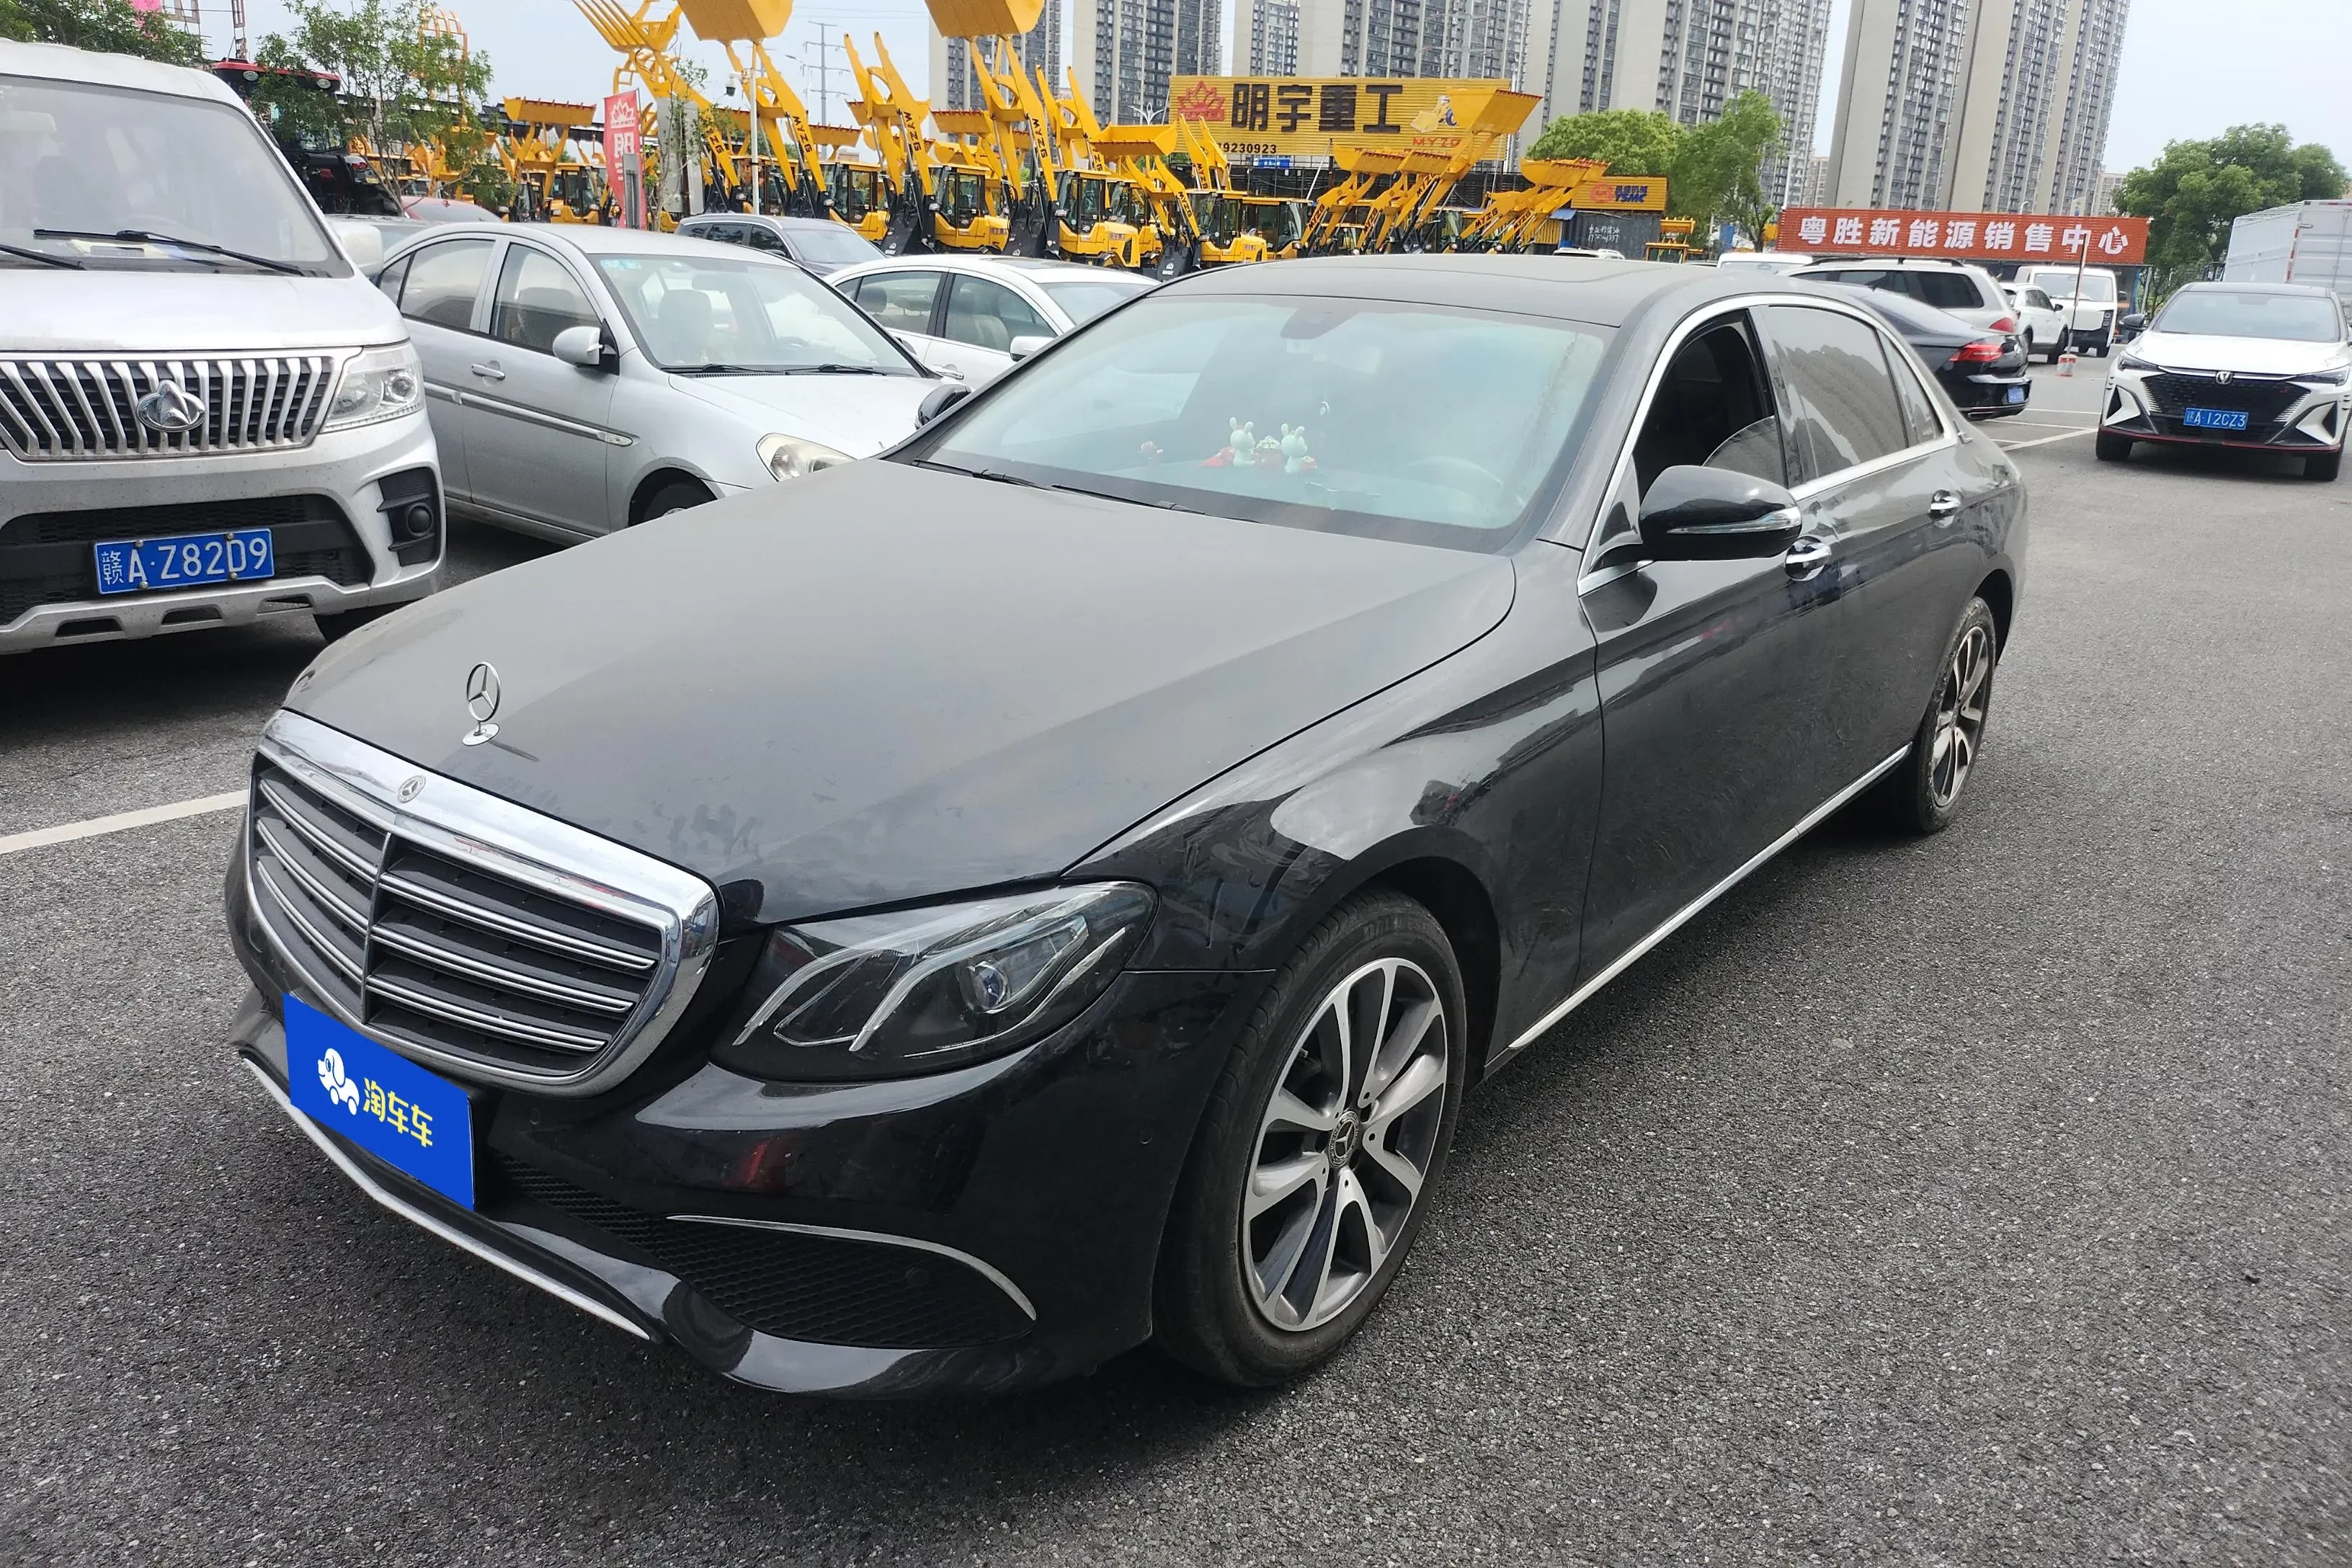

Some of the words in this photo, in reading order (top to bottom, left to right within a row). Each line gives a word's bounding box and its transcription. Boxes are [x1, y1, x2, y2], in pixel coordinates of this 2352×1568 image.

[1231, 83, 1403, 133] 明宇重工
[793, 115, 813, 153] MYZG
[904, 111, 922, 151] MYZG
[1032, 117, 1048, 159] MYZG
[1196, 163, 1209, 190] MYZG
[1178, 191, 1193, 218] MYZG
[1309, 203, 1325, 230] MYZG
[1363, 207, 1378, 235] MYZG
[1475, 208, 1498, 228] MYZG
[1513, 210, 1531, 230] MYZG
[1798, 215, 2128, 255] 粤胜新能源销售中心
[101, 537, 267, 585] 赣A·Z82D9
